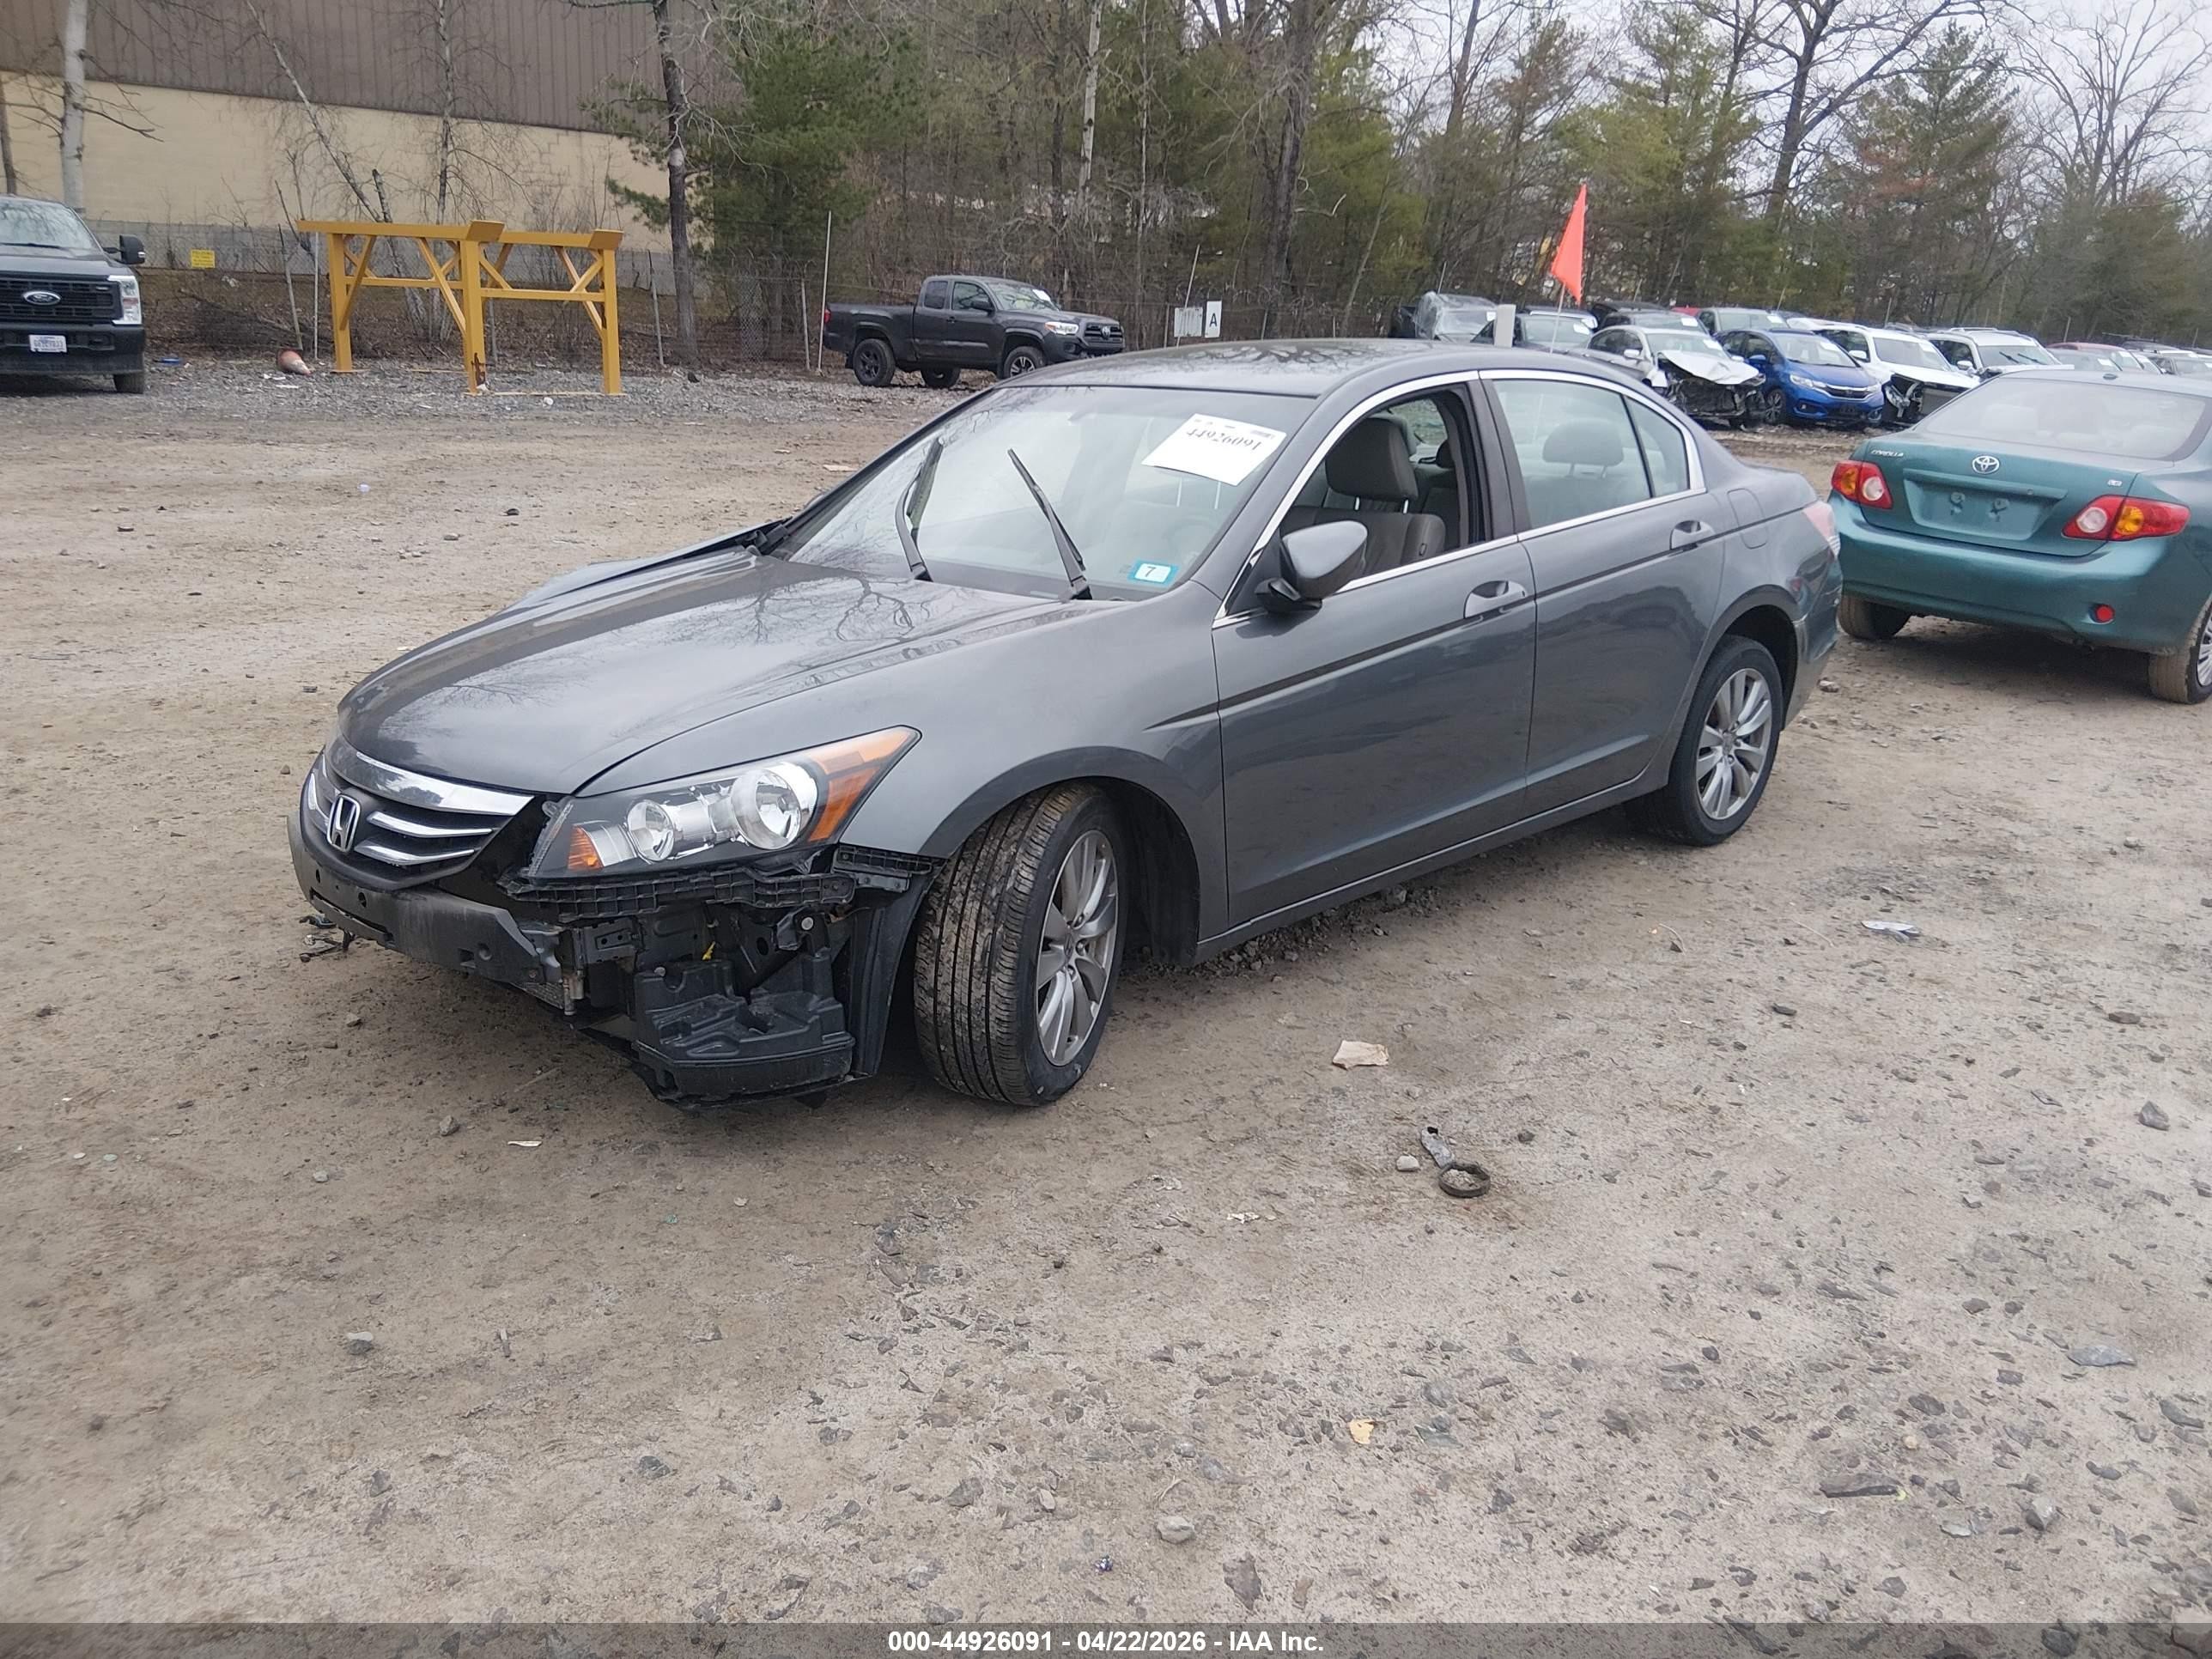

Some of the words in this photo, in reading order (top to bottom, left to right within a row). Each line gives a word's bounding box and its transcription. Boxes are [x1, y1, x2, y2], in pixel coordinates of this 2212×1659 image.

[1209, 312, 1218, 328] A
[1186, 428, 1263, 451] 44926091
[1144, 565, 1158, 578] 7
